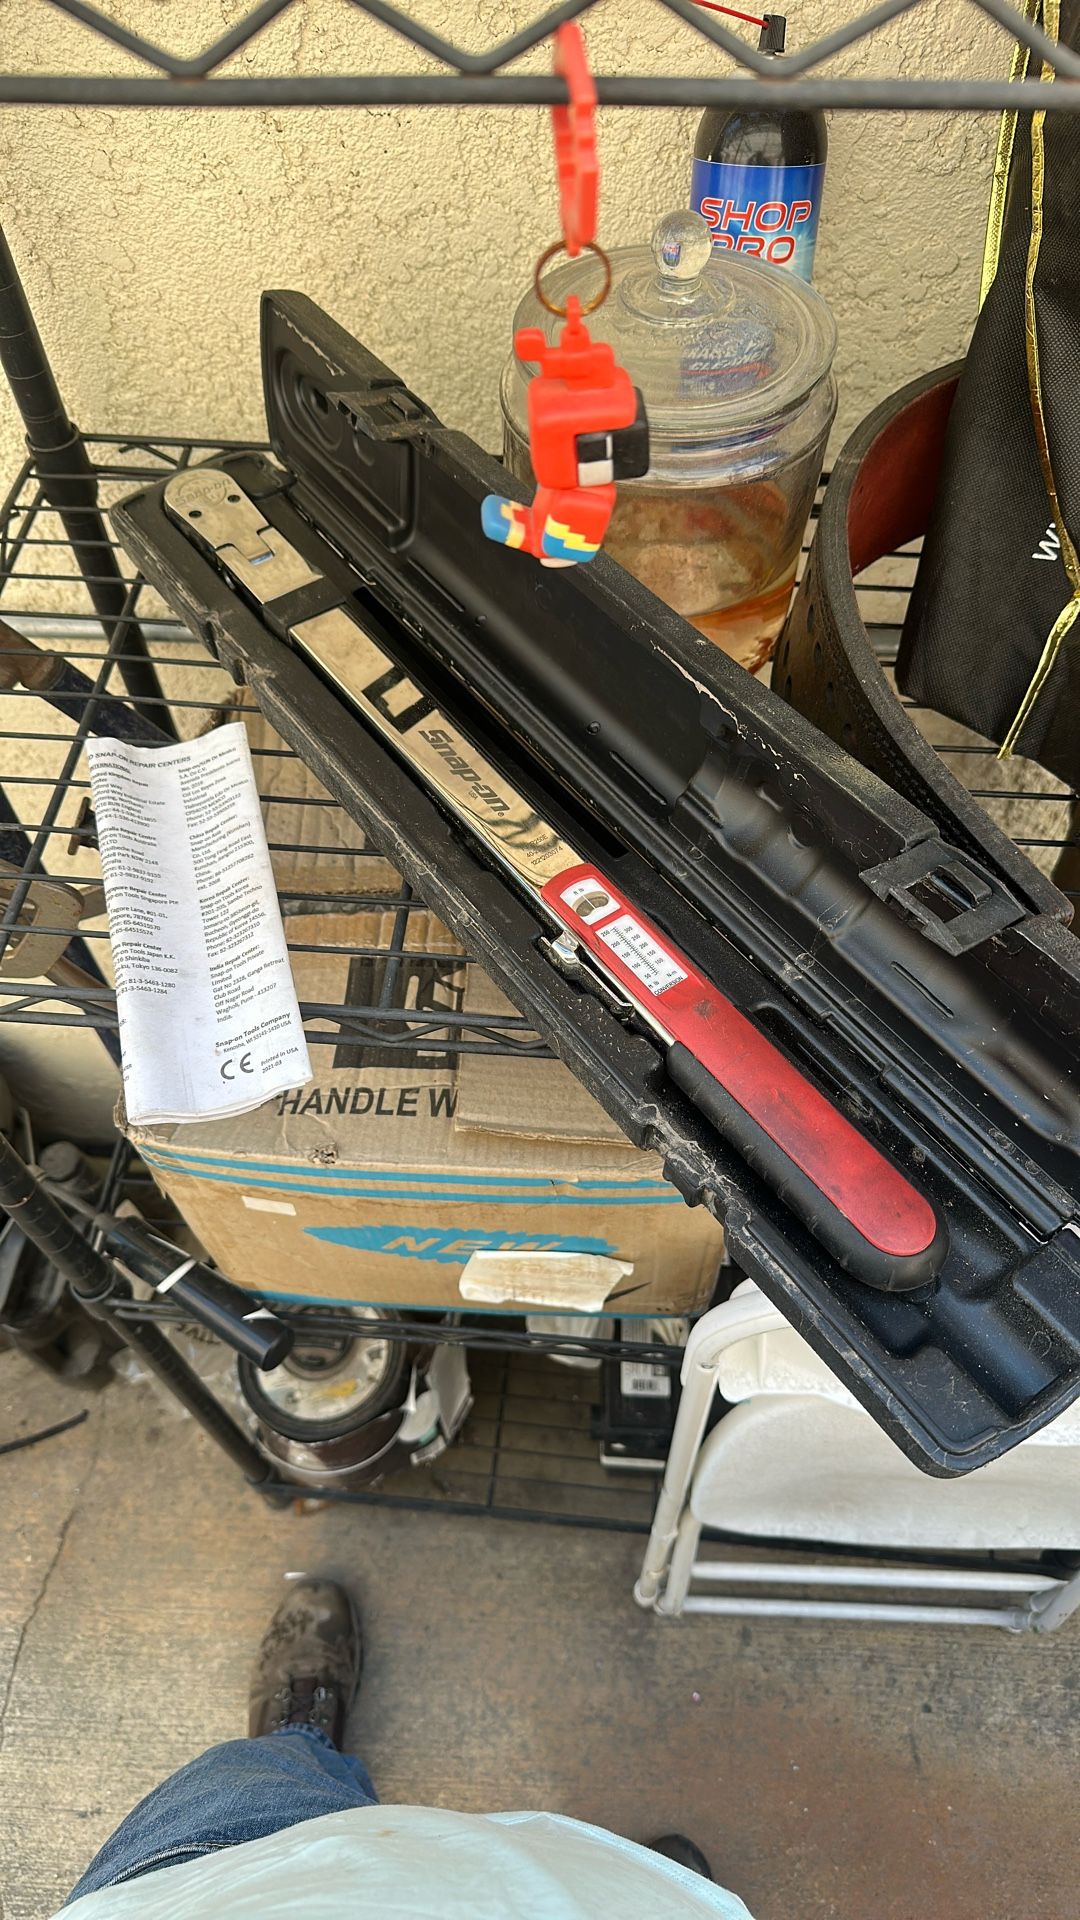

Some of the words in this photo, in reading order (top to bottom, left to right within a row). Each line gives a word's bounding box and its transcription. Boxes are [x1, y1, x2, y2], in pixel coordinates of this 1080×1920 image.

[700, 197, 812, 232] SHOP
[95, 752, 128, 763] SNAP-ON
[129, 759, 156, 768] REPAIR
[158, 756, 191, 768] CENTERS
[418, 730, 510, 811] Snap-on
[191, 834, 226, 852] Manufacturing
[129, 886, 147, 894] Repair
[200, 899, 221, 910] Snap-on
[222, 892, 234, 900] Tools
[235, 884, 249, 893] Korea
[216, 886, 231, 896] Repair
[244, 885, 262, 896] Techno
[141, 895, 167, 904] Singapore
[131, 907, 145, 915] Lane,
[202, 915, 219, 923] Tower
[205, 932, 228, 943] Republic
[235, 921, 248, 930] Korea
[143, 943, 161, 951] Center
[207, 942, 225, 950] Phone:
[225, 955, 240, 966] Repair
[242, 945, 260, 957] Center:
[211, 968, 233, 978] Snap-on
[233, 960, 246, 969] Tools
[247, 950, 264, 961] Private
[212, 974, 232, 986] Limited
[247, 967, 263, 978] Ganga
[214, 992, 226, 1000] Club
[227, 985, 241, 995] Road
[654, 976, 683, 995] CONVERSION
[215, 1000, 224, 1008] Off
[225, 994, 241, 1004] Nagar
[241, 986, 254, 996] Road
[216, 1002, 240, 1015] Wagholi,
[241, 995, 254, 1005] Pune
[217, 1014, 232, 1023] India.
[215, 1034, 243, 1048] Snap-on
[243, 1026, 260, 1037] Tools
[261, 1012, 290, 1028] Company
[223, 1042, 246, 1053] Kenosha,
[261, 1053, 279, 1066] Printed
[286, 1047, 298, 1055] USA
[220, 1052, 254, 1080] CE
[262, 1060, 282, 1074] 2021-03
[277, 1087, 420, 1117] HANDLE
